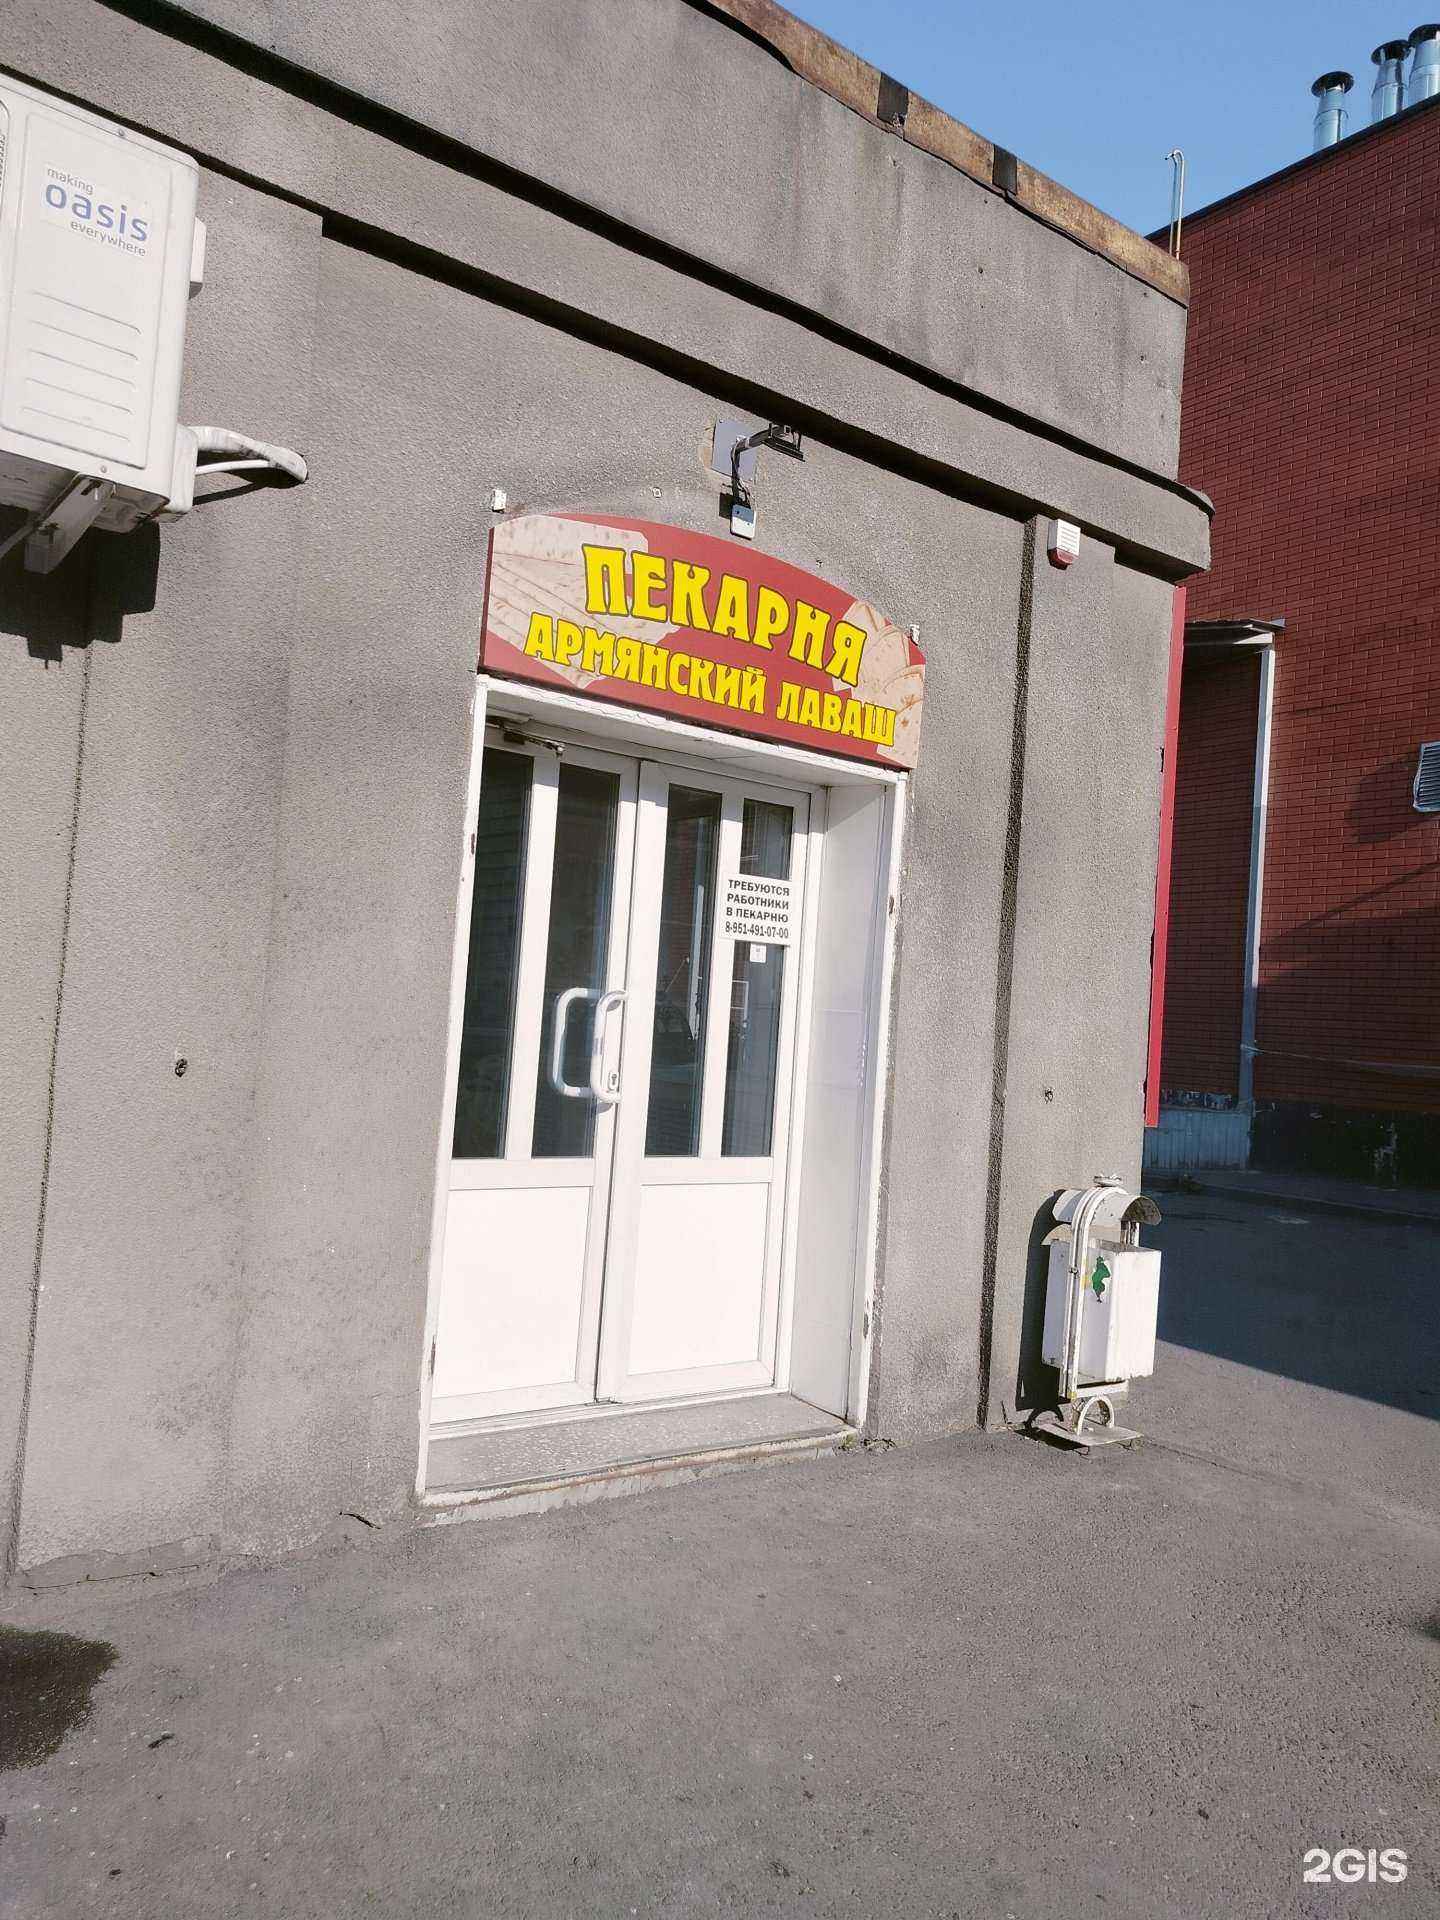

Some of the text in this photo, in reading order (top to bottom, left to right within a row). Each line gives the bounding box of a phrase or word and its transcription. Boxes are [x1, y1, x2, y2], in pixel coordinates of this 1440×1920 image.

[47, 167, 93, 195] making
[45, 183, 149, 242] oasis
[70, 219, 146, 257] everywhere
[581, 543, 868, 688] ПЕКАРНЯ
[523, 611, 897, 747] АРМЯНСКИЙ ЛАВАШ
[727, 893, 789, 910] РАБОТНИКИ
[728, 879, 790, 896] ТРЕБУЮТСЯ
[726, 907, 789, 923] В ПЕКАРНЮ
